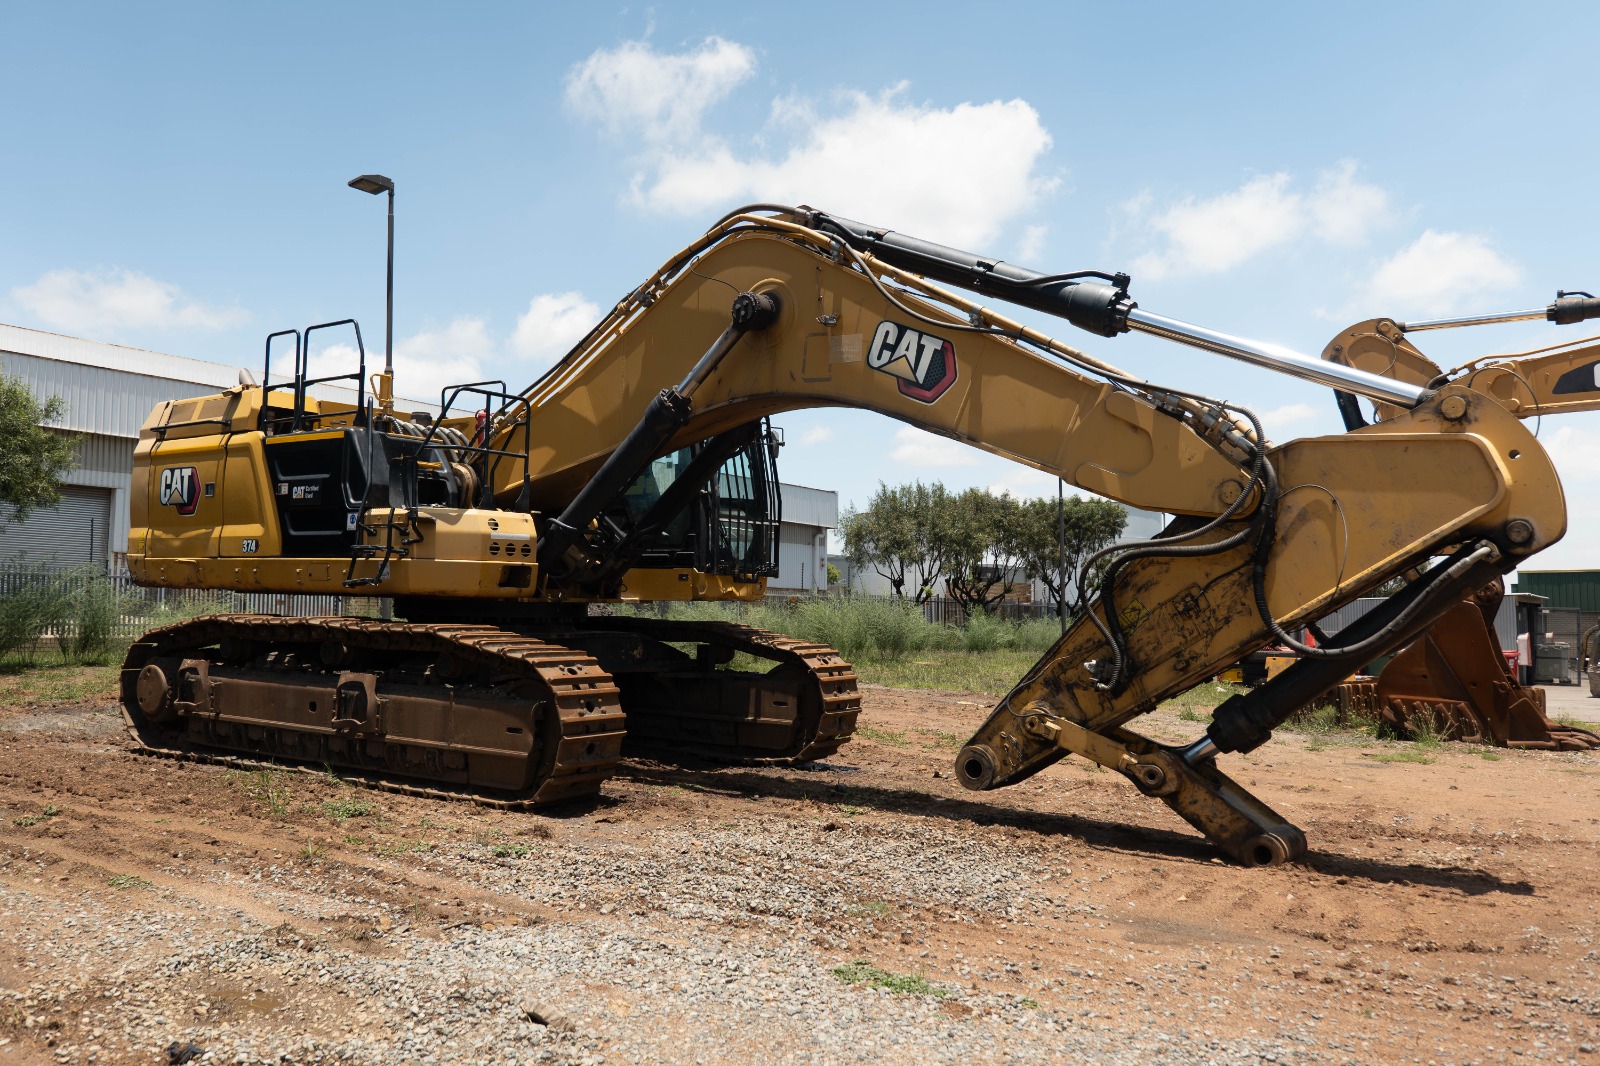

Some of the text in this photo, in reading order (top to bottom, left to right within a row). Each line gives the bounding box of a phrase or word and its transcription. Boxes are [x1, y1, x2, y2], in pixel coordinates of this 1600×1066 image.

[868, 321, 944, 385] CAT
[160, 467, 192, 504] CAT
[292, 486, 305, 499] CAT
[242, 539, 256, 552] 374
